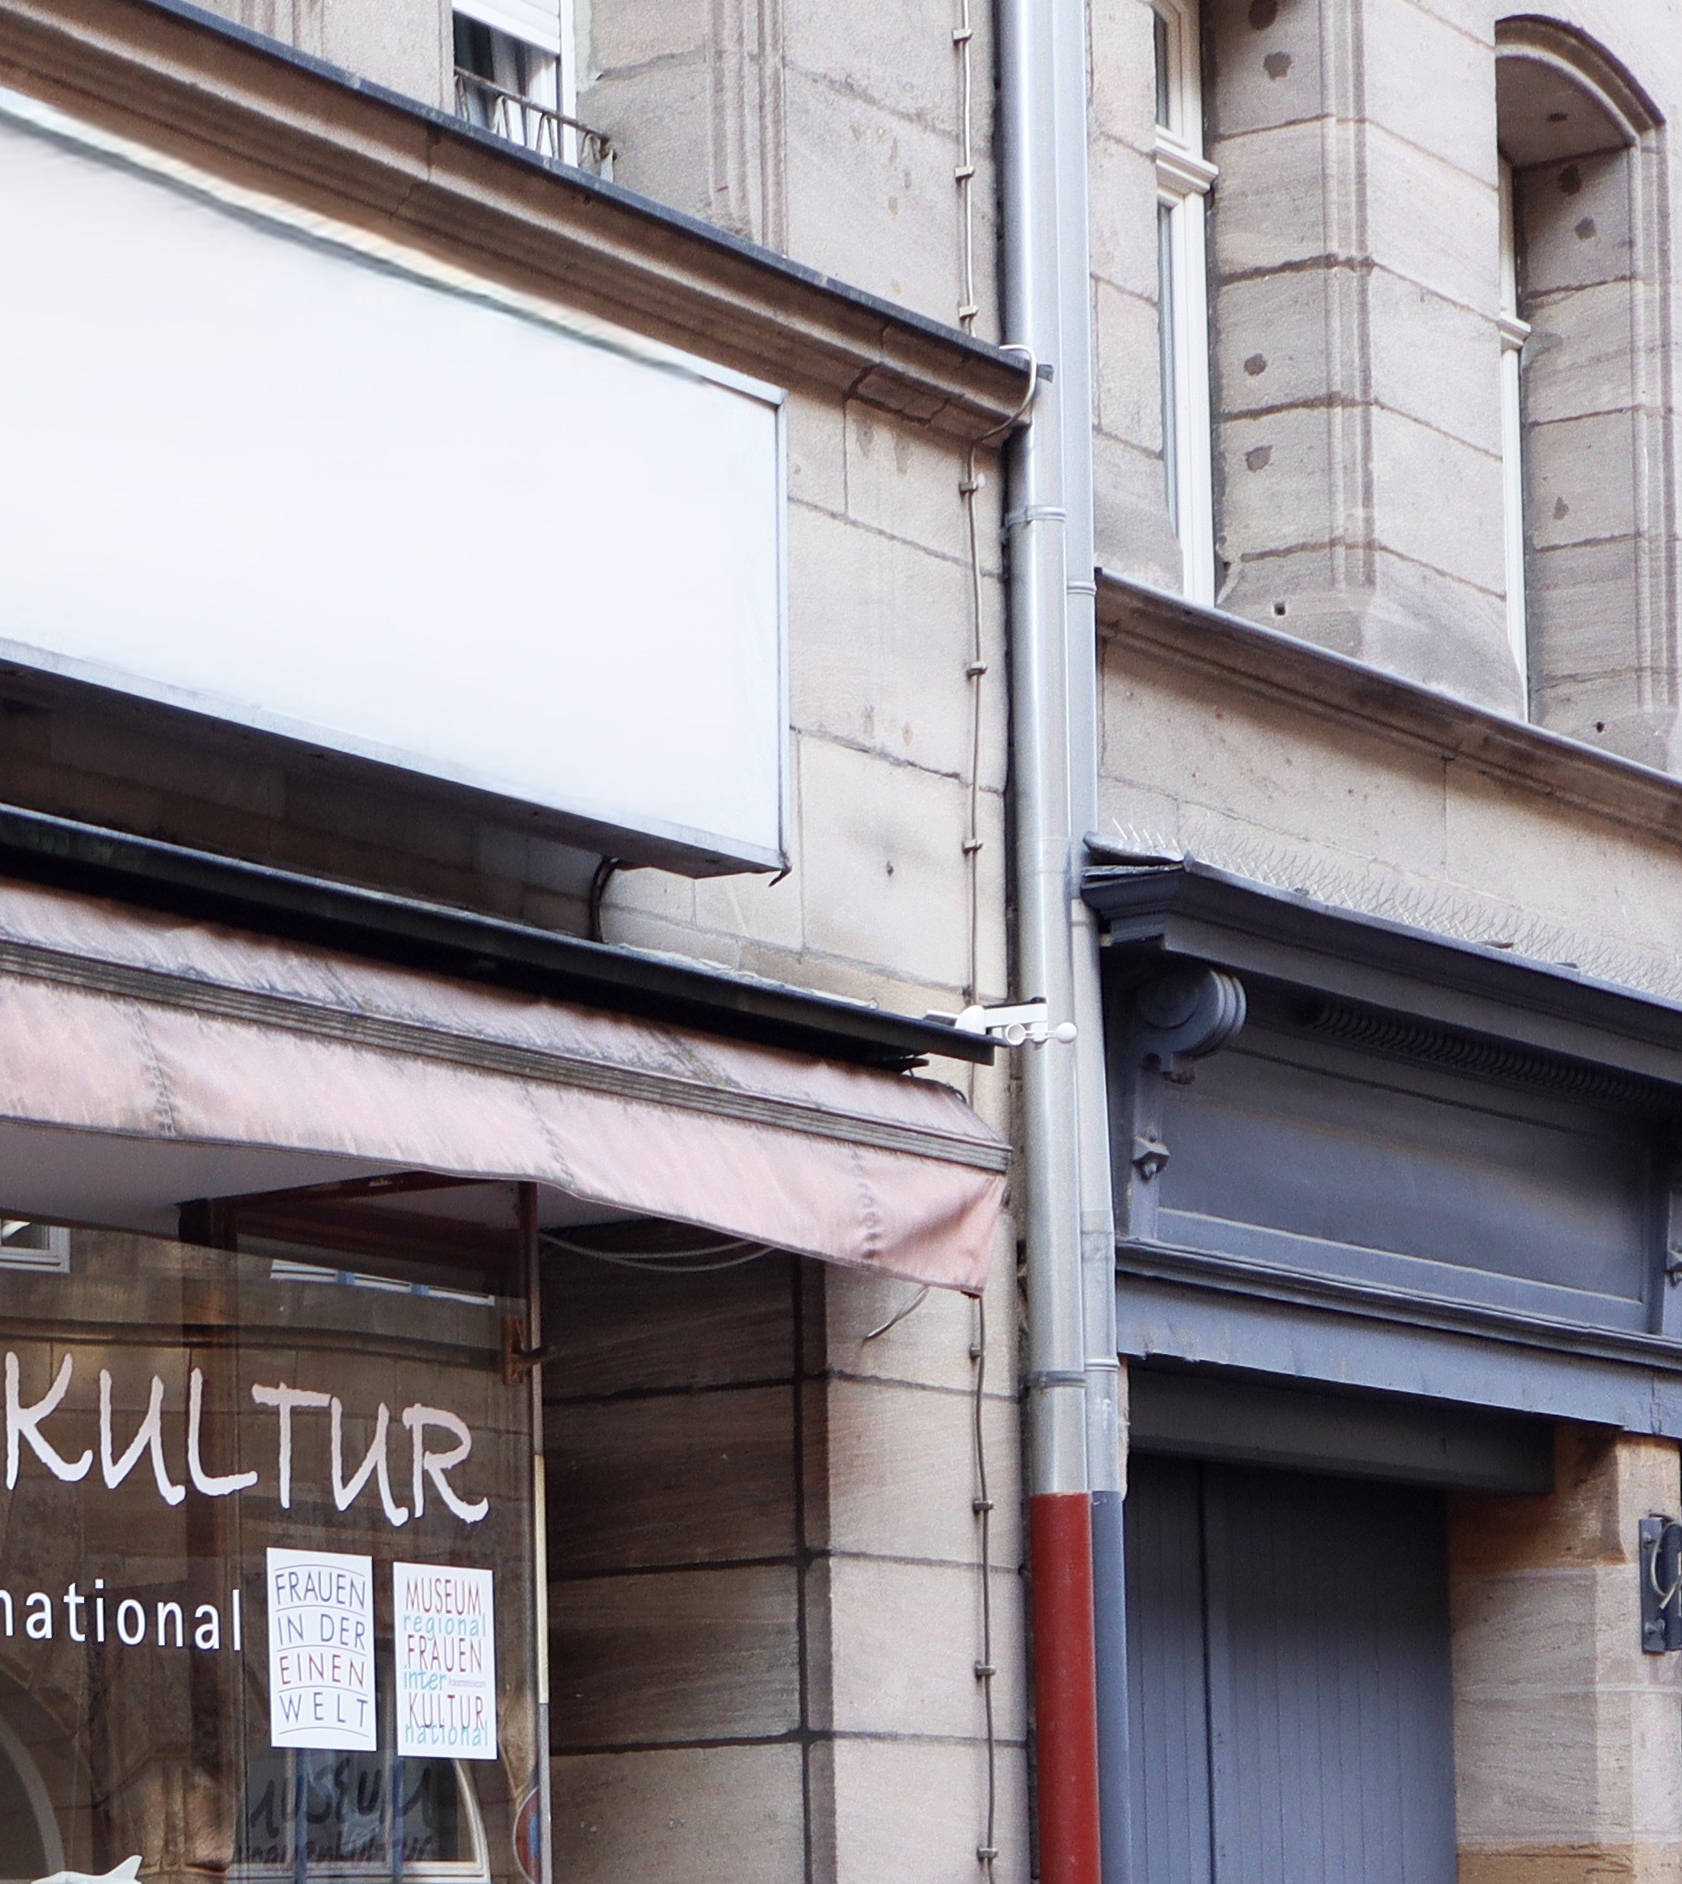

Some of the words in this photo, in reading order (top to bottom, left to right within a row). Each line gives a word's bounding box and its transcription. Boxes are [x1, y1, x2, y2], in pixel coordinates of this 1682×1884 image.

[275, 1571, 366, 1610] FRAUEN
[406, 1576, 481, 1616] MUSEUM
[278, 1614, 304, 1646] IN
[320, 1613, 366, 1650] DER
[403, 1612, 486, 1640] regional
[279, 1652, 365, 1688] EINEN
[407, 1634, 483, 1672] FRAUEN
[404, 1664, 447, 1691] inter
[279, 1692, 368, 1727] WELT
[408, 1692, 485, 1730] KULTUR
[405, 1718, 488, 1747] national
